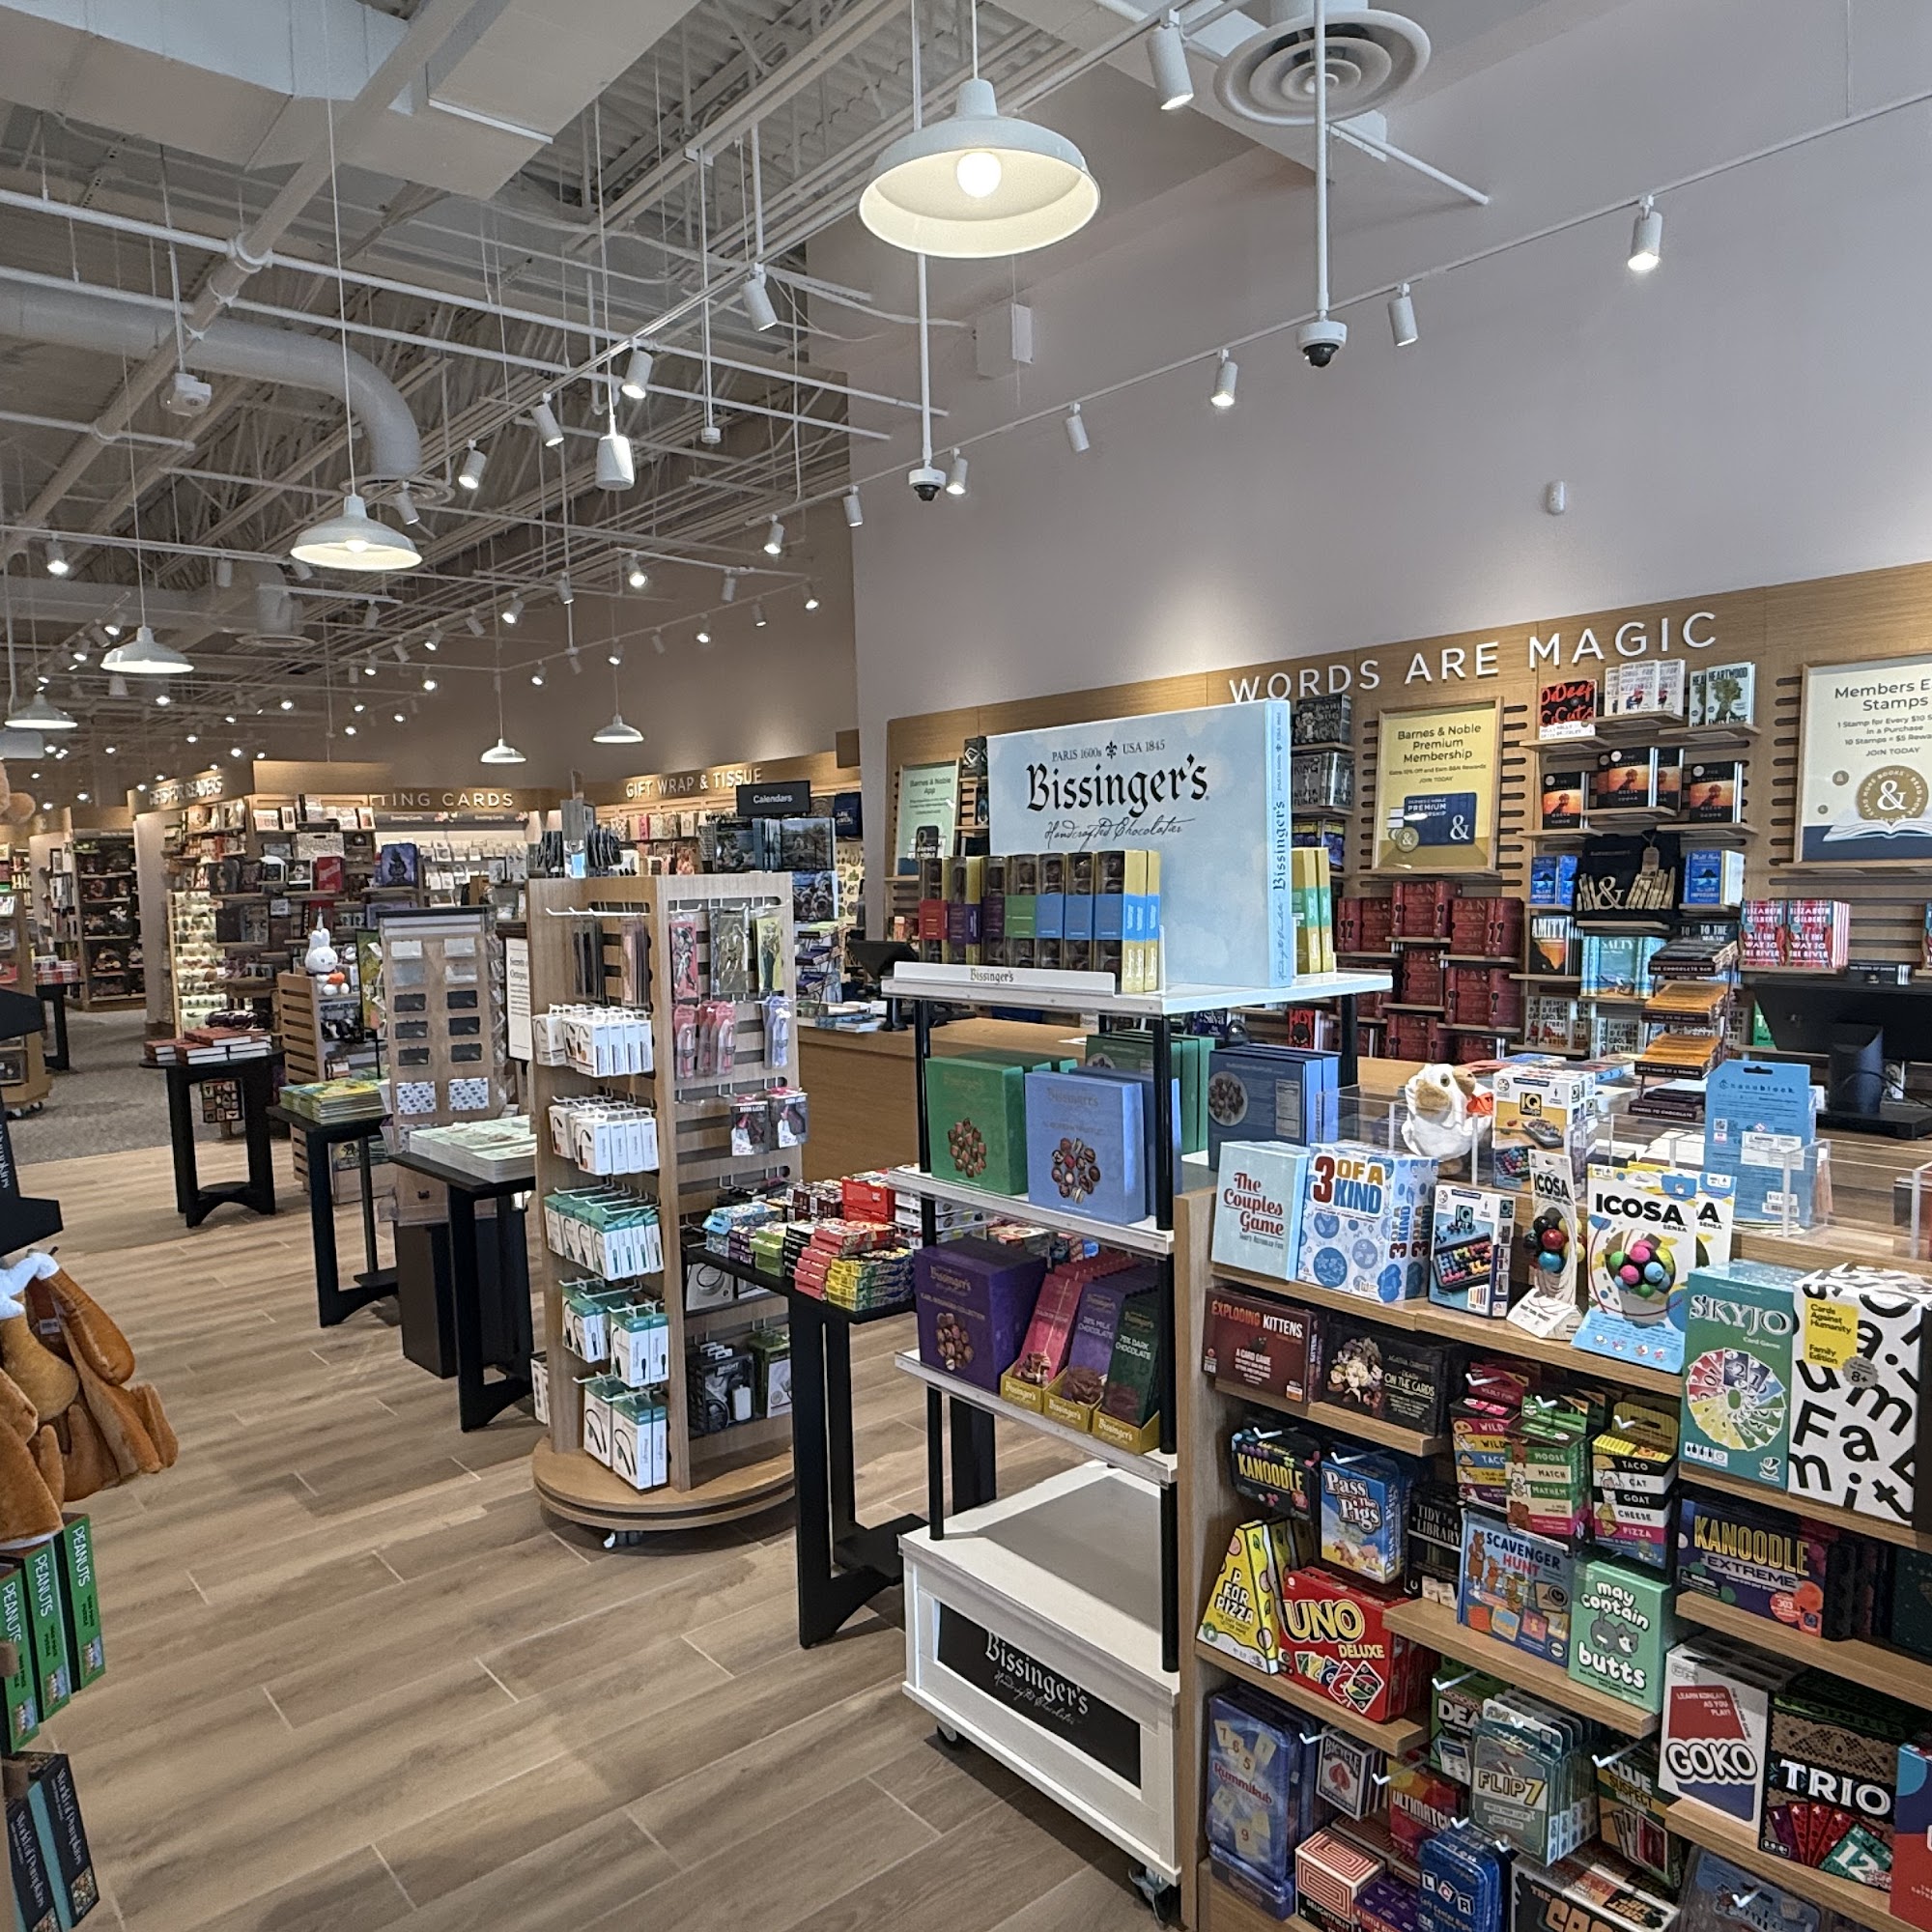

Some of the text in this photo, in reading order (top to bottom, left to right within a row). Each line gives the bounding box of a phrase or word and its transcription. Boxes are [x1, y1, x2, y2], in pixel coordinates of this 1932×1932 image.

[1229, 611, 1717, 702] WORDS ARE MAGIC
[1708, 667, 1747, 681] HEARTWOOD
[1834, 681, 1915, 698] Members
[1862, 696, 1928, 712] Stamps
[1398, 724, 1481, 740] Barnes & Noble
[1884, 725, 1923, 734] Purchase
[1051, 739, 1165, 762] PARIS 1600s USA 1845
[1413, 738, 1463, 751] Premium
[1856, 737, 1888, 746] Stamps
[1889, 747, 1920, 755] TODAY
[1404, 749, 1472, 763] Membership
[626, 768, 762, 798] GIFT WRAP & TISSUE
[1026, 753, 1208, 818] Bissinger's
[442, 792, 514, 808] CARDS
[753, 794, 793, 805] Calendars
[1877, 780, 1908, 810] &
[1272, 800, 1288, 892] Bissinger's
[1531, 917, 1566, 938] AMITY
[1700, 923, 1727, 936] TO THE
[1601, 939, 1635, 951] SALTY
[970, 969, 1013, 983] Bissinger's
[1520, 1093, 1542, 1112] IQ
[1234, 1172, 1262, 1193] The
[1314, 1156, 1383, 1204] 3 OF A
[1533, 1173, 1570, 1200] ICOSA
[1224, 1188, 1283, 1217] Couples
[1334, 1179, 1382, 1214] KIND
[1457, 1208, 1473, 1221] IQ
[1595, 1193, 1687, 1226] ICOSA
[1239, 1210, 1284, 1236] Game
[1662, 1224, 1688, 1233] SENSA
[1698, 1221, 1722, 1231] SENSA
[1211, 1300, 1304, 1338] EXPLODING KITTENS
[1689, 1293, 1793, 1337] SKYJO
[1810, 1303, 1836, 1315] Cards
[1810, 1311, 1843, 1325] Against
[1078, 1322, 1114, 1340] CHOCOLATE
[1095, 1321, 1112, 1330] MILK
[1810, 1320, 1852, 1335] Humanity
[1115, 1343, 1151, 1361] CHOCOLATE
[1132, 1339, 1150, 1350] DARK
[1743, 1336, 1781, 1350] Card Game
[1808, 1344, 1837, 1356] Family
[1808, 1352, 1838, 1365] Edition
[1384, 1372, 1435, 1397] ON THE CARDS
[1851, 1371, 1868, 1382] 8+
[1005, 1380, 1037, 1401] Bissinger's
[1048, 1399, 1081, 1421] Bissinger's
[1098, 1417, 1133, 1441] Bissinger's
[1480, 1422, 1504, 1433] WILD
[1481, 1440, 1504, 1450] WILD
[1534, 1451, 1566, 1463] MOOSE
[1622, 1459, 1648, 1471] TACO
[1236, 1452, 1304, 1492] KANOODLE
[1538, 1469, 1566, 1480] MATCH
[1323, 1470, 1367, 1497] Pass
[1532, 1486, 1567, 1497] MAYHEM
[1629, 1478, 1646, 1488] CAT
[1623, 1493, 1650, 1505] GOAT
[1339, 1497, 1380, 1532] Pigs
[1417, 1504, 1441, 1523] TIDY
[1618, 1509, 1652, 1522] CHEESE
[1416, 1518, 1461, 1547] LIBRARY
[1622, 1525, 1653, 1538] PIZZA
[72, 1525, 91, 1587] PEANUTS
[1486, 1532, 1561, 1571] SCAVENGER
[1694, 1515, 1810, 1577] KANOODLE
[1503, 1552, 1541, 1577] HUNT
[1708, 1556, 1797, 1590] EXTREME
[34, 1553, 53, 1618] PEANUTS
[1233, 1569, 1243, 1584] P
[1223, 1581, 1250, 1605] FOR
[1596, 1581, 1635, 1606] may
[1214, 1594, 1255, 1625] PIZZA
[1580, 1593, 1650, 1631] contain
[1284, 1600, 1365, 1642] UNO
[1338, 1643, 1386, 1660] DELUXE
[985, 1632, 1090, 1716] Bissinger's
[1577, 1640, 1647, 1690] butts
[1676, 1691, 1698, 1700] LEARN
[1324, 1739, 1362, 1777] BICYCLE
[1666, 1742, 1758, 1781] GOKO
[1213, 1760, 1273, 1805] Rummikub
[1607, 1759, 1652, 1796] CLUE
[1779, 1758, 1891, 1816] TRIO
[1479, 1771, 1546, 1806] FLIP 7
[1608, 1775, 1653, 1809] SUSPECT
